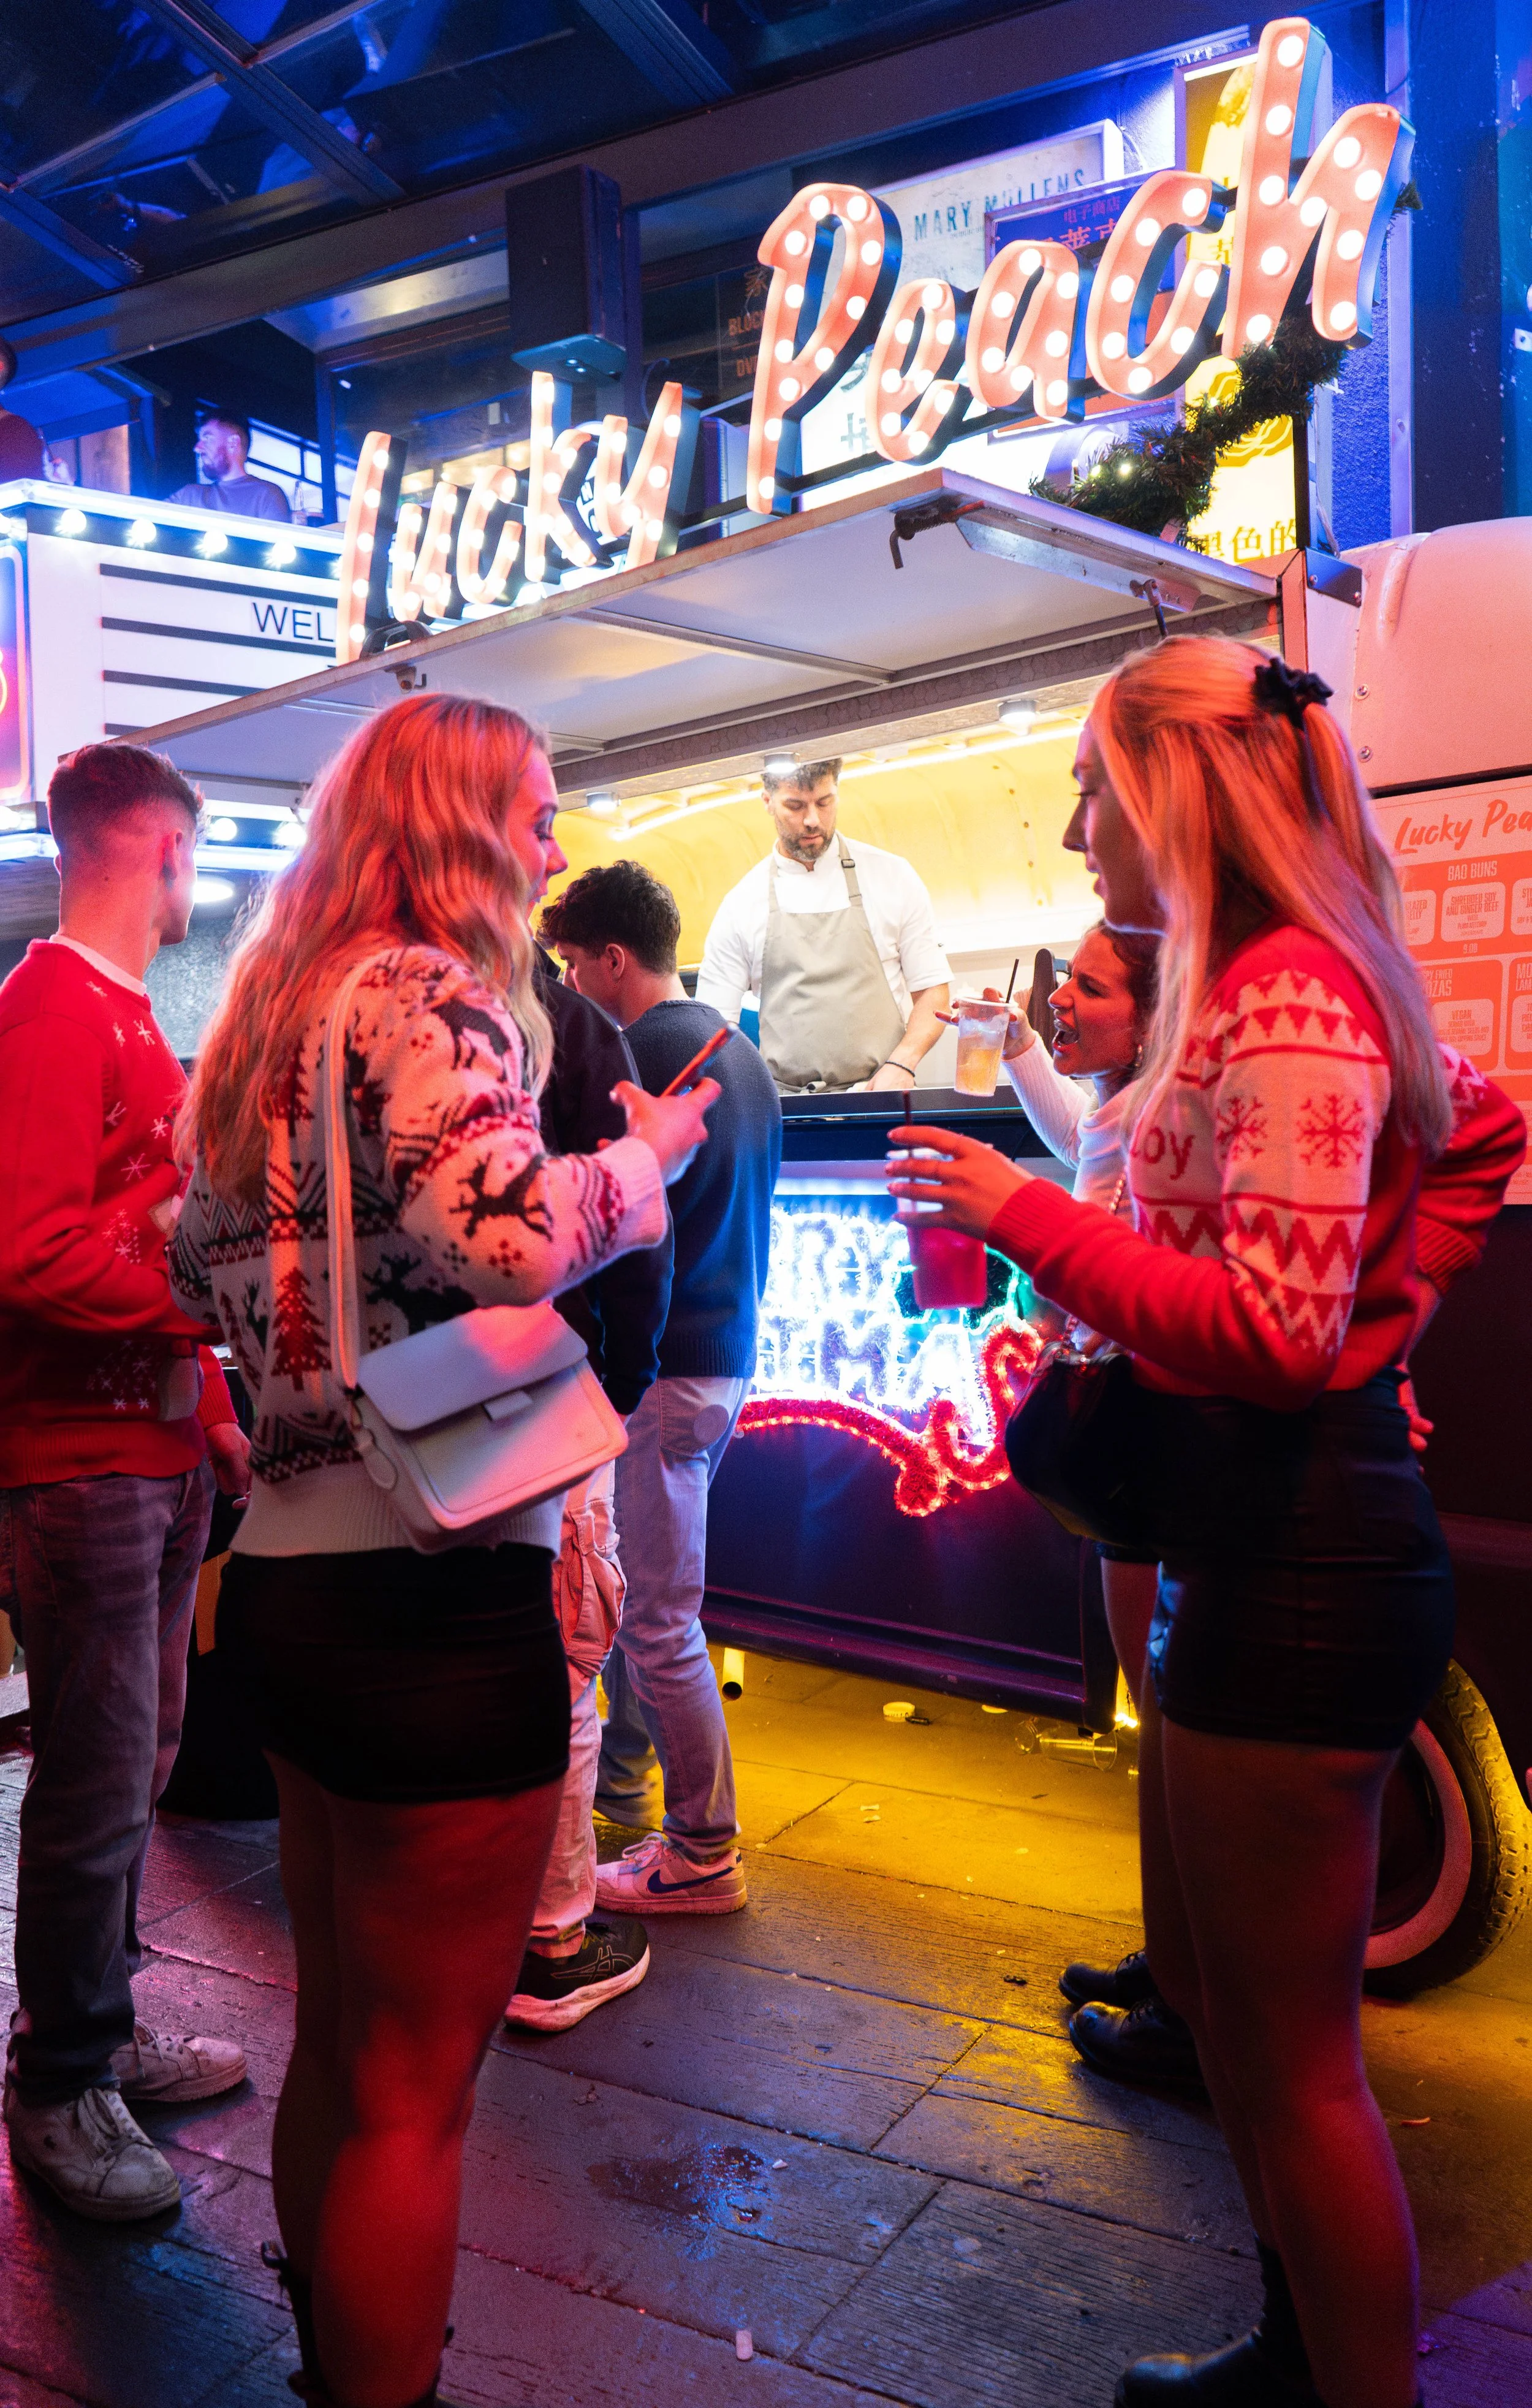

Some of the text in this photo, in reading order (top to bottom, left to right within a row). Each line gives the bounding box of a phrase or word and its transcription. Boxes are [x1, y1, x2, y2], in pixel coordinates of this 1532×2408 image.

[914, 200, 973, 241] MARY
[746, 17, 1414, 516] Peach
[252, 602, 335, 643] WEL
[1394, 813, 1473, 854] Lucky
[1447, 860, 1498, 881] BAO BUNS
[1435, 968, 1453, 980] FRIED
[1451, 1009, 1472, 1020] VEGAN
